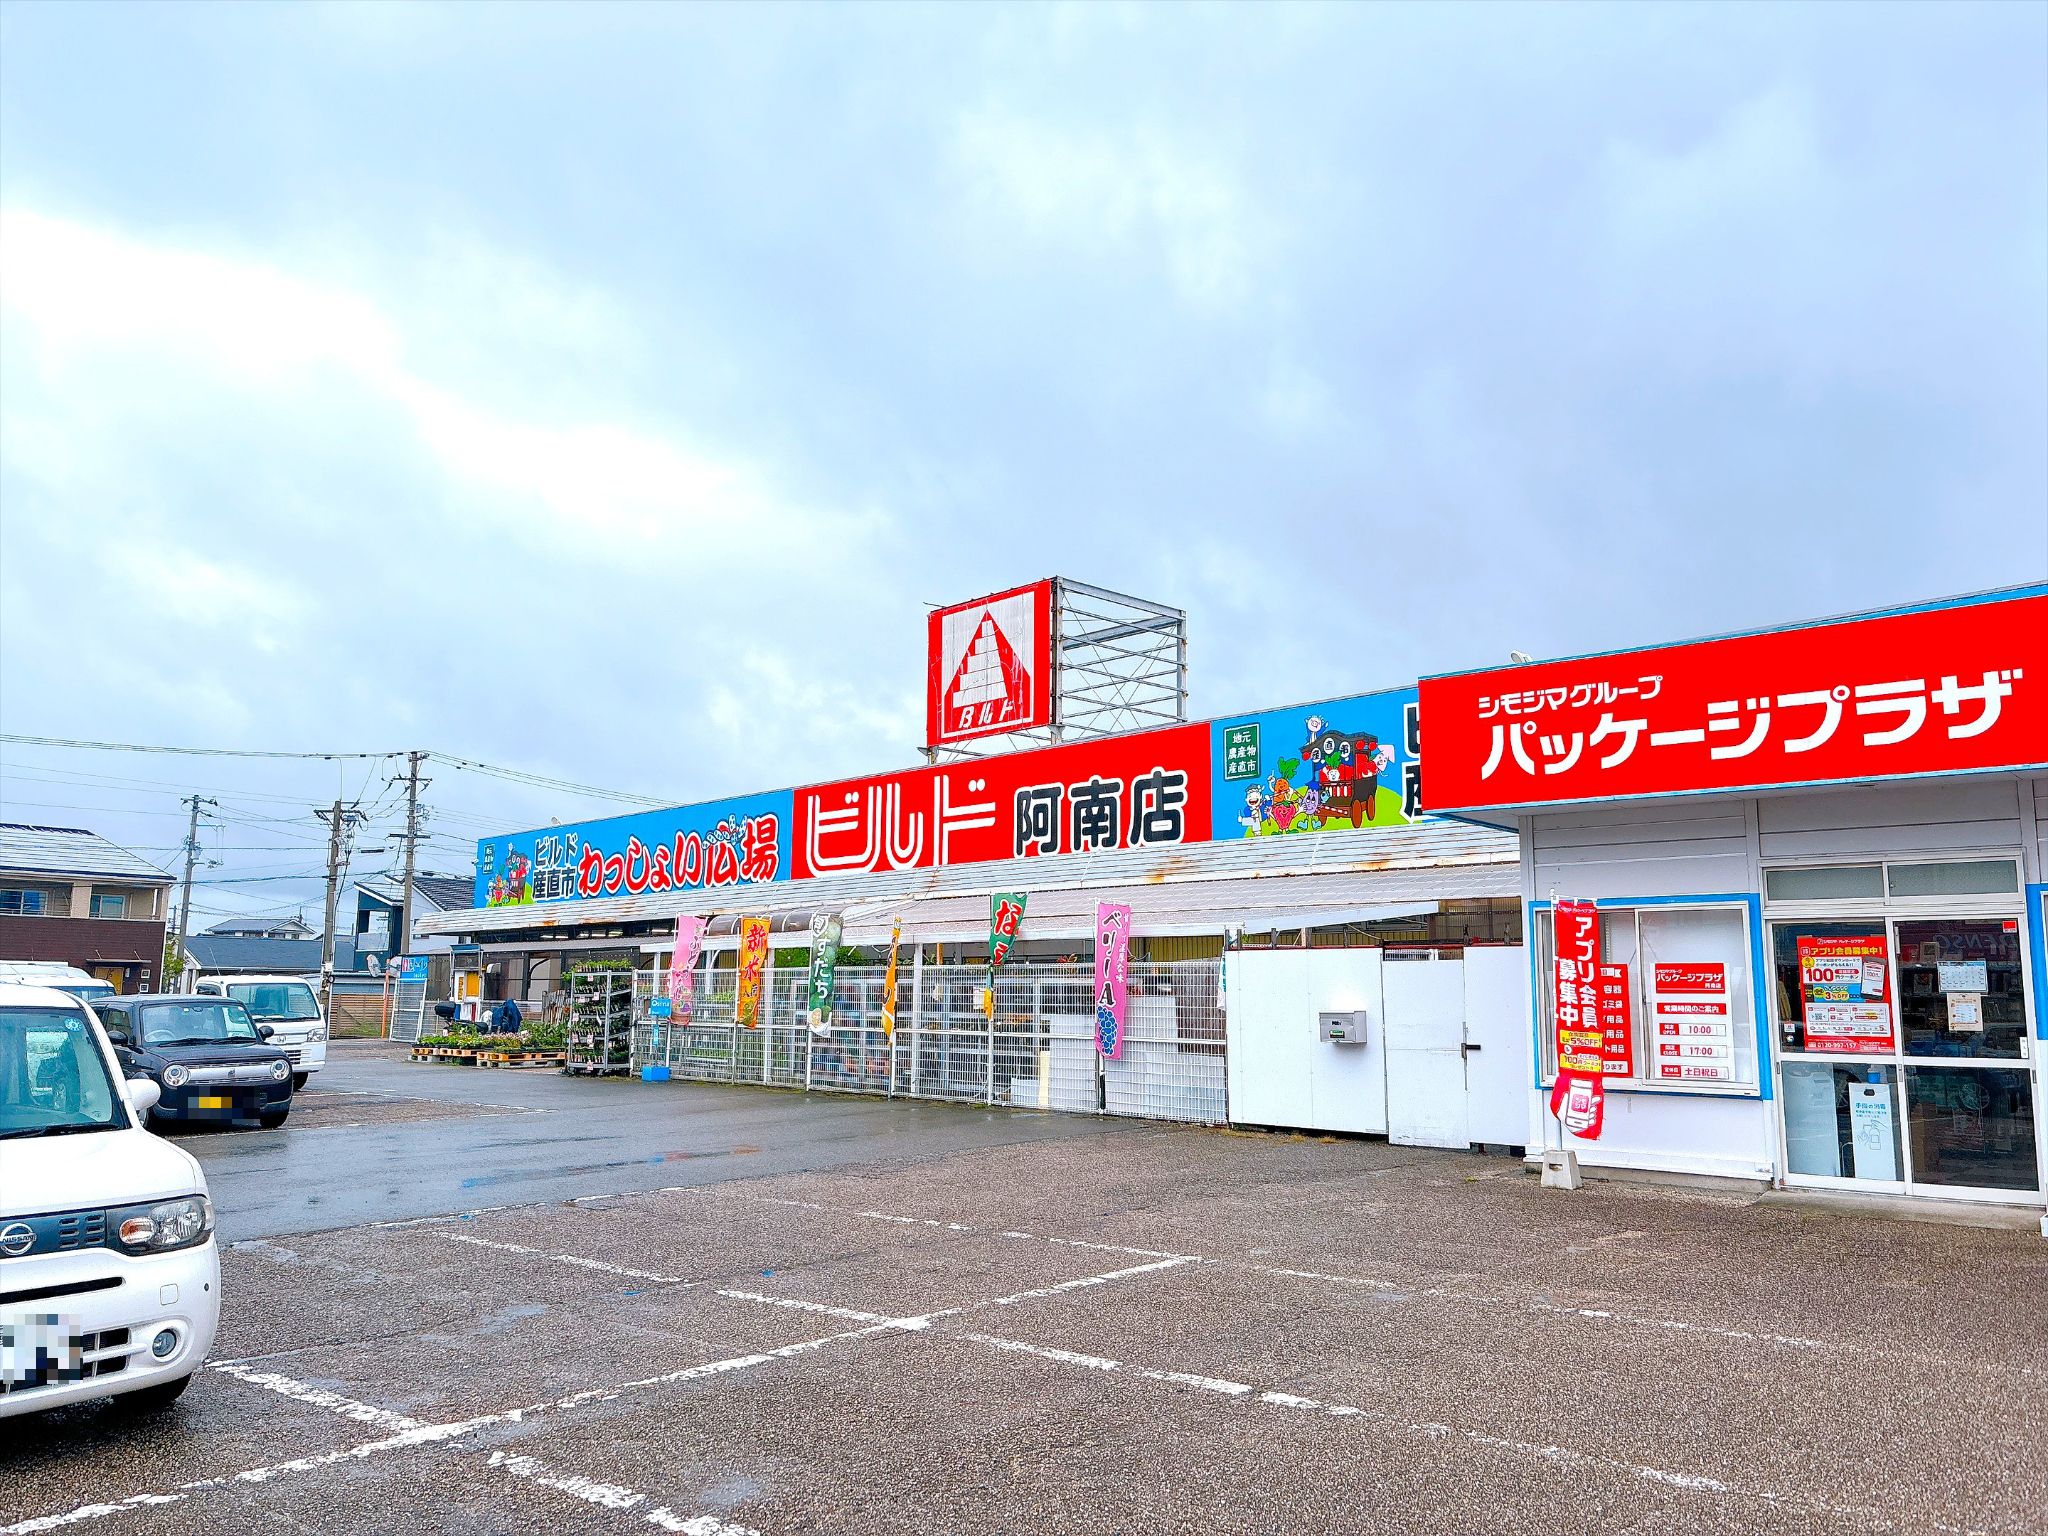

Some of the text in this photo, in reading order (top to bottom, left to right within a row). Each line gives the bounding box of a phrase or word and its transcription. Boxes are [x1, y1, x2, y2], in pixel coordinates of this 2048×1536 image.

[1478, 675, 1663, 719] シモジマグループ
[1481, 669, 2023, 780] パッケージプラザ
[1232, 731, 1251, 744] 地元
[1228, 745, 1256, 760] 農産物
[1228, 759, 1256, 774] 産直市
[806, 766, 1188, 877] ビルド 阿南店
[535, 832, 578, 869] ビルド
[577, 813, 780, 898] わっしょい広場
[532, 865, 577, 900] 産直市
[744, 923, 766, 982] 新米
[1099, 910, 1122, 1007] ベリーA
[1810, 947, 1883, 955] アプリ会員募集中!
[814, 937, 831, 999] すだち
[1576, 916, 1598, 1029] アプリ会員
[1806, 969, 1834, 982] 100
[1656, 973, 1723, 982] パッケージプラザ
[1559, 958, 1579, 1027] 募集中
[1664, 1005, 1719, 1013] 営業時間のご案内
[1603, 1015, 1623, 1023] 用品
[1604, 1029, 1624, 1038] 用品
[1688, 1025, 1712, 1034] 10:00
[1571, 1037, 1599, 1046] 5%OFF
[1690, 1047, 1713, 1055] 17:00
[1684, 1068, 1718, 1077] 土日祝日
[2, 1234, 35, 1243] NISSAN
